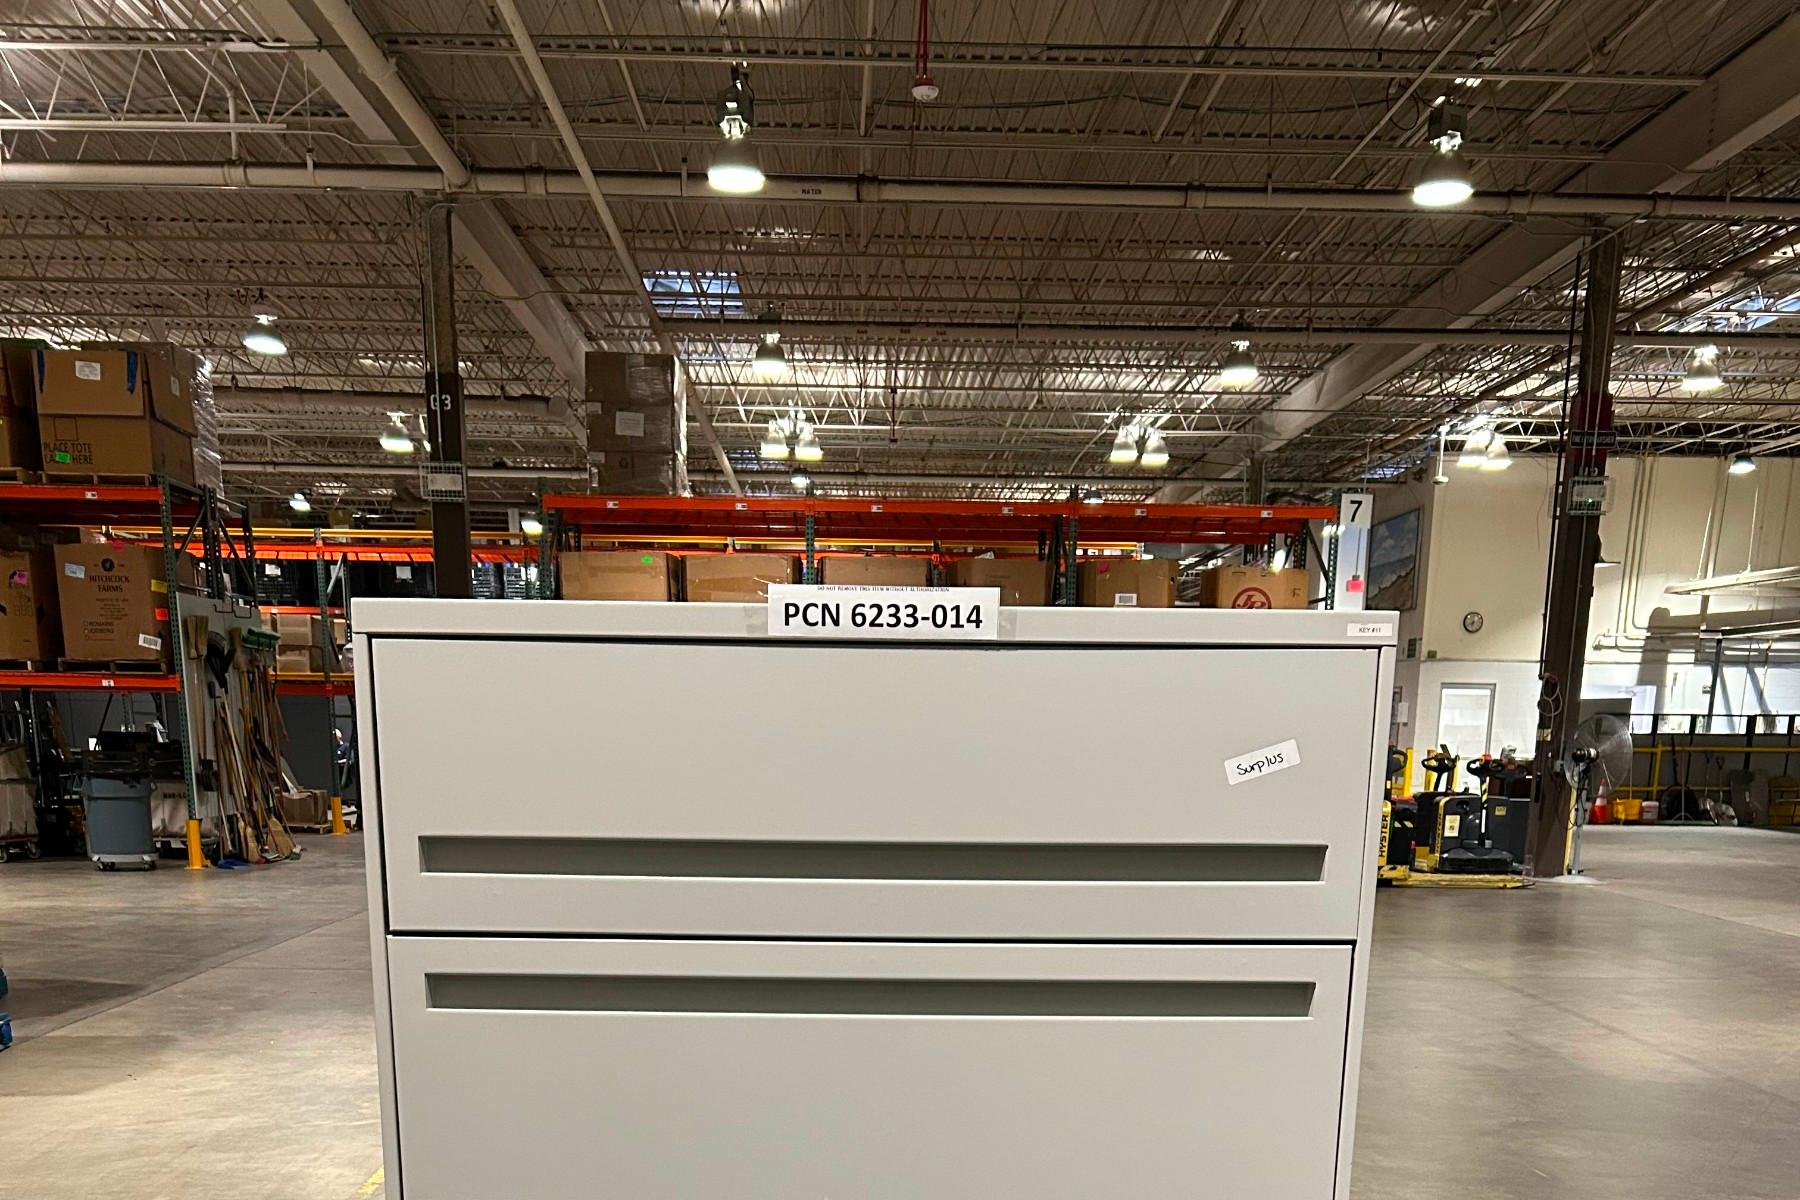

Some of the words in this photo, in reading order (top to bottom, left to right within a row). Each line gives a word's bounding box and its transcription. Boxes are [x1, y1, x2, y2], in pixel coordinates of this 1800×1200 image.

[71, 443, 93, 454] TOTE
[1350, 500, 1363, 523] 7
[89, 575, 130, 583] HITCHCOCK
[97, 584, 124, 593] FARMS
[784, 602, 840, 627] PCN
[851, 603, 983, 629] 6233-014
[1236, 752, 1284, 776] Surplus
[1378, 814, 1390, 858] HYSTER
